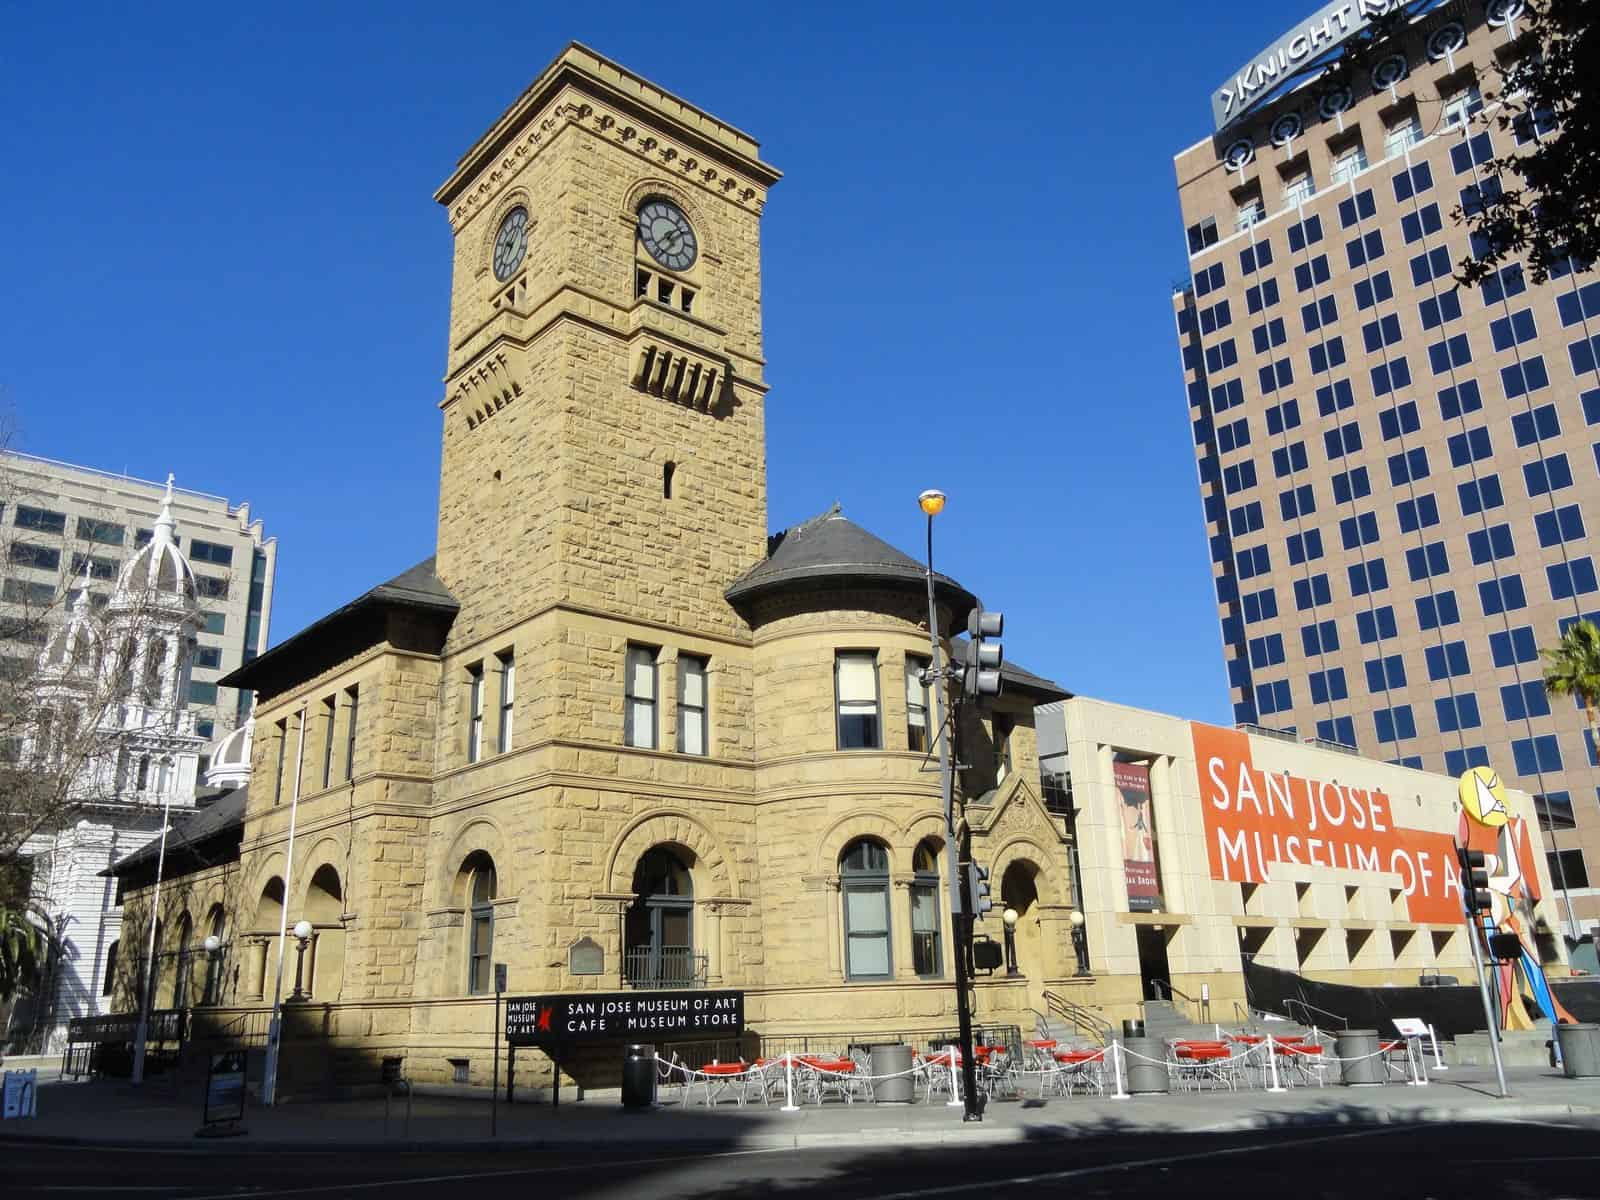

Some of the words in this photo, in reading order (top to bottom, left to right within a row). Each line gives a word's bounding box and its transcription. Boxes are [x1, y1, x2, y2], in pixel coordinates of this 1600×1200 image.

[1208, 756, 1295, 819] SAN
[1306, 778, 1386, 833] JOSE
[1391, 848, 1433, 897] OF
[507, 1002, 520, 1011] SAN
[522, 1002, 536, 1013] JOSE
[567, 1003, 595, 1015] SAN
[600, 1001, 631, 1016] JOSE
[637, 999, 688, 1012] MUSEUM
[694, 999, 709, 1010] OF
[715, 998, 737, 1009] ART
[507, 1013, 536, 1024] MUSEUM
[567, 1019, 607, 1032] CAFE
[628, 1015, 686, 1029] MUSEUM
[694, 1013, 737, 1026] STORE
[506, 1025, 517, 1034] OF
[521, 1025, 536, 1033] ART
